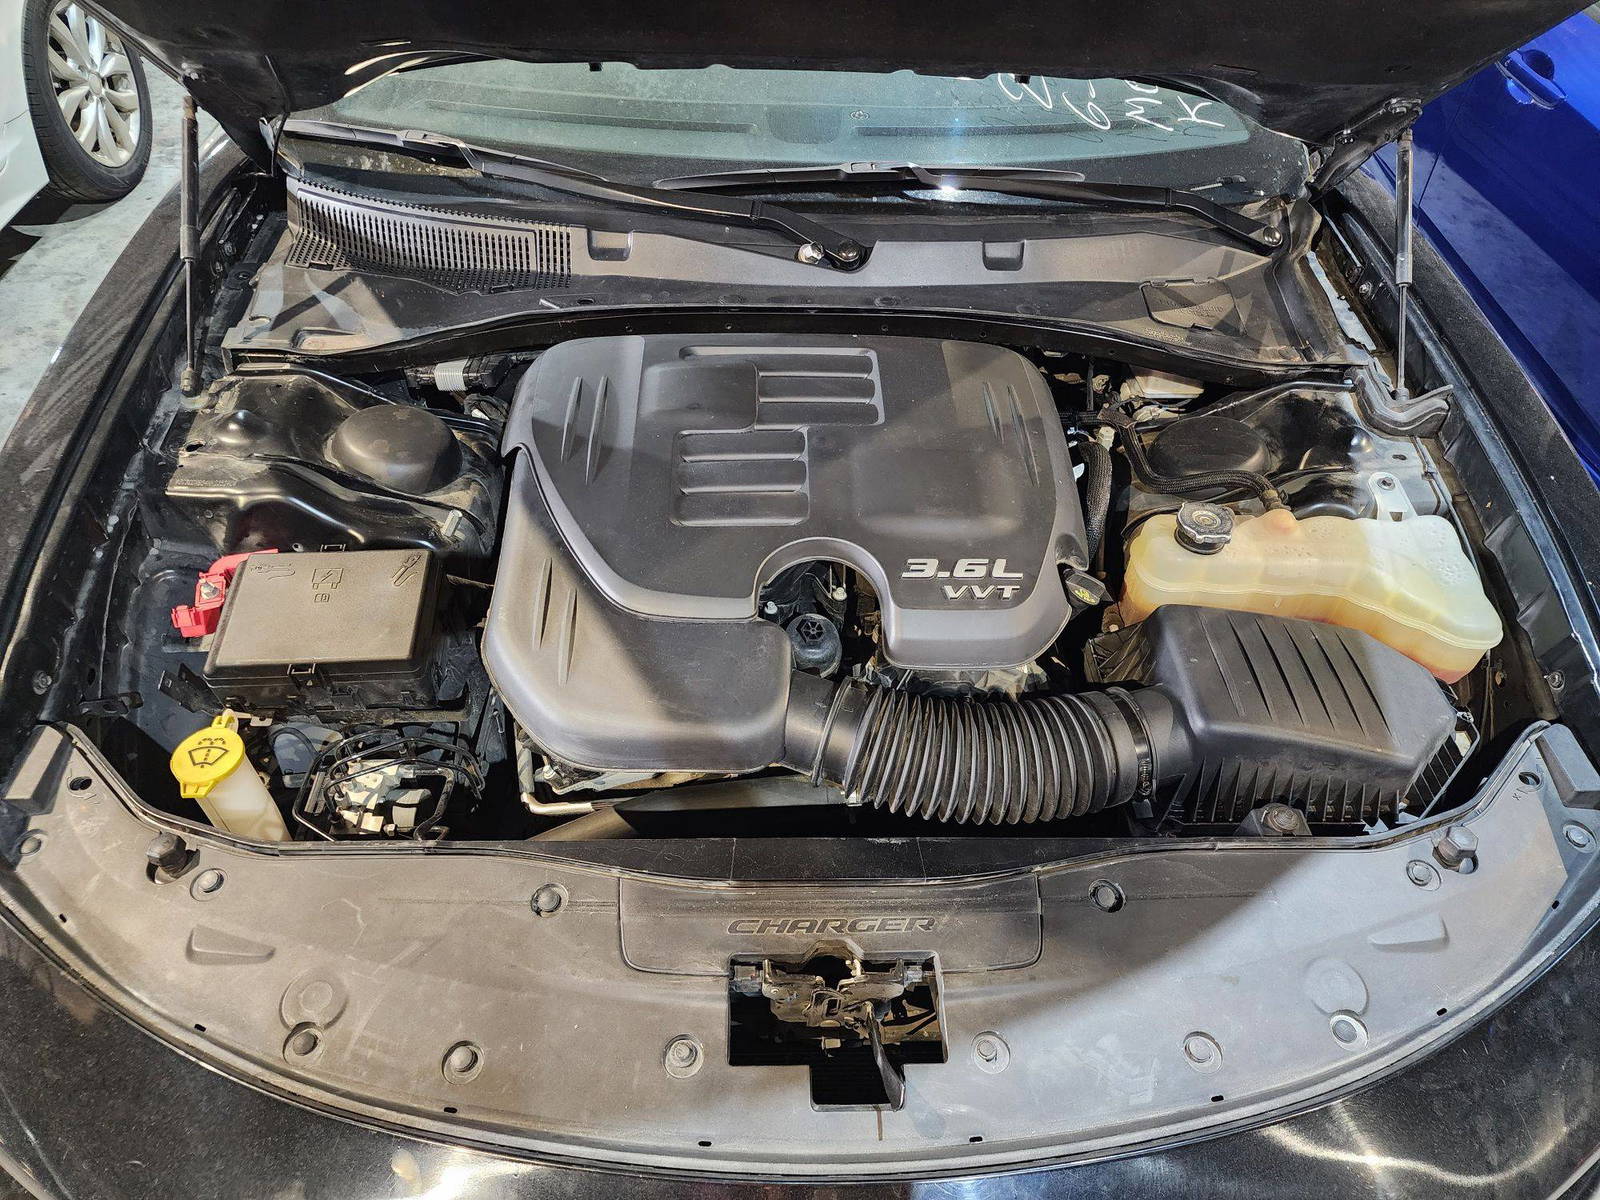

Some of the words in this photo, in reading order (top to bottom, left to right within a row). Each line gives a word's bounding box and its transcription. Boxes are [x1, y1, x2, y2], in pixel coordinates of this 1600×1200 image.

[901, 558, 1024, 580] 3.6L
[943, 585, 1021, 600] VVT
[727, 917, 937, 934] CHARGER
